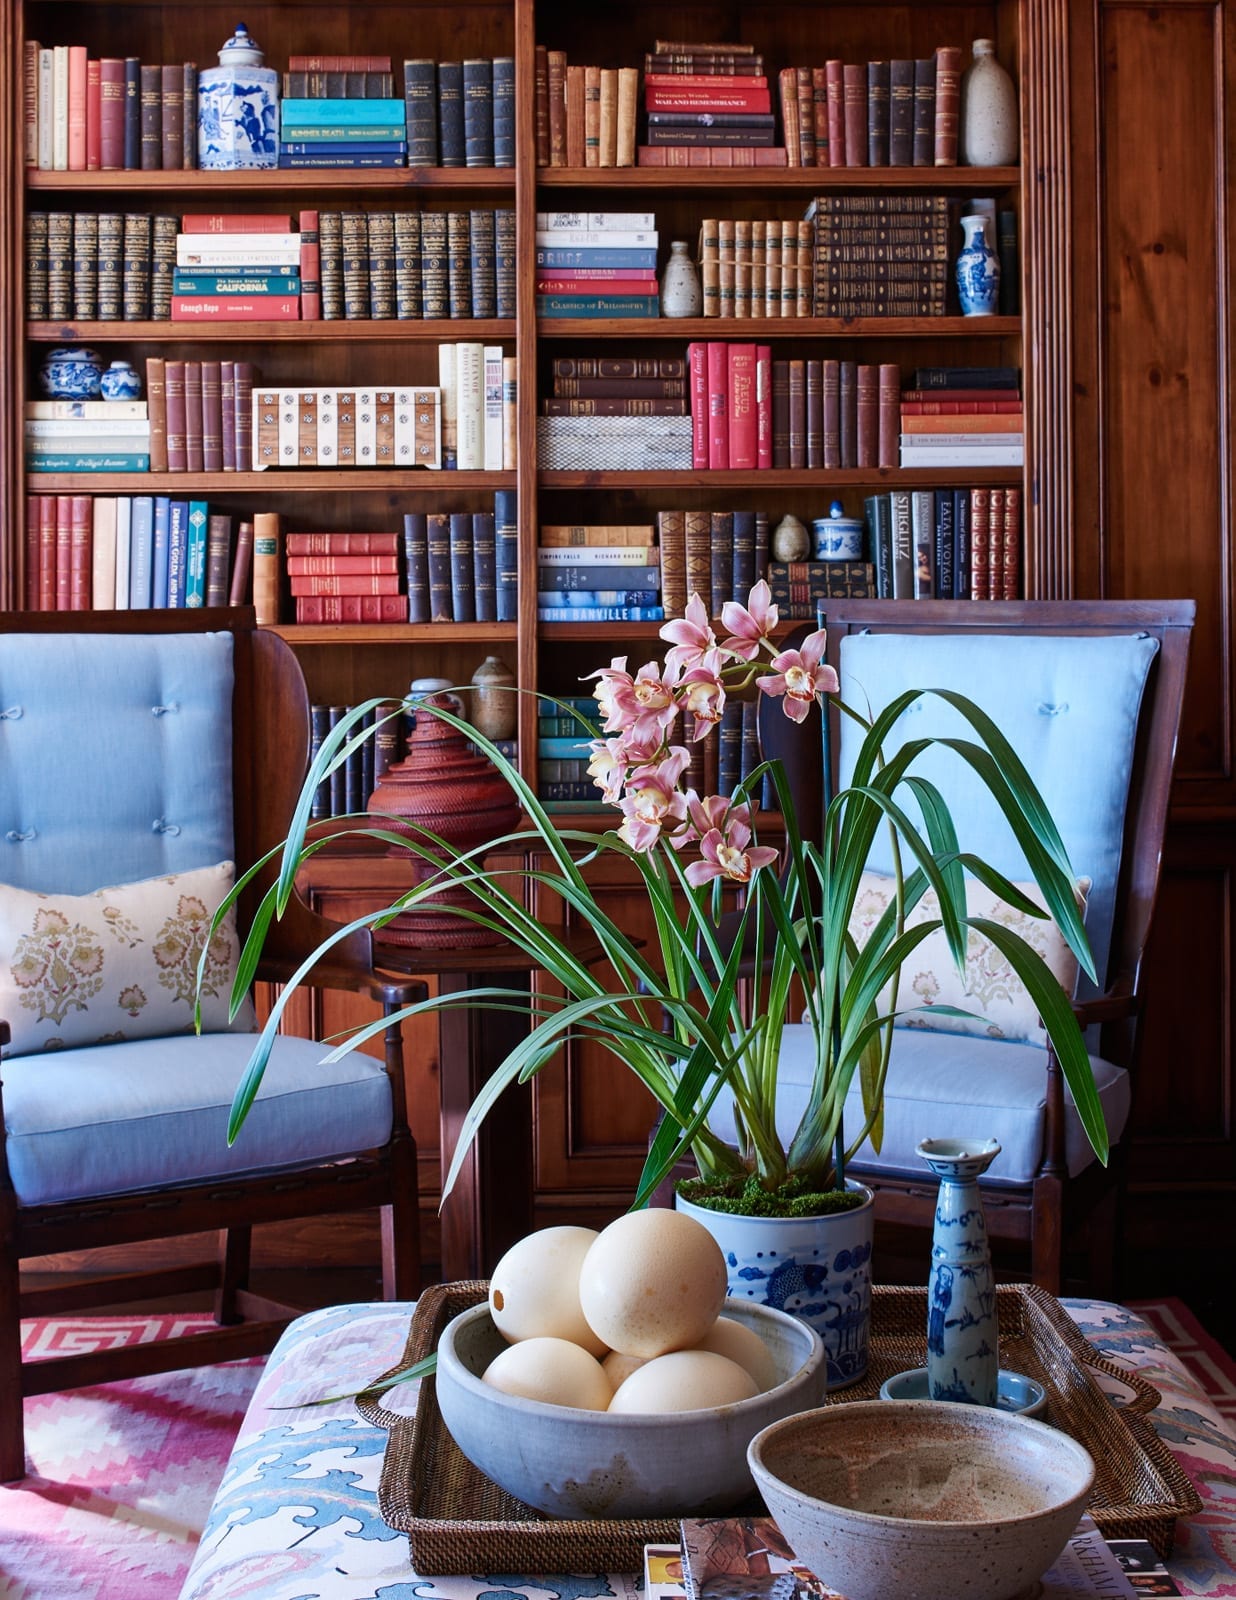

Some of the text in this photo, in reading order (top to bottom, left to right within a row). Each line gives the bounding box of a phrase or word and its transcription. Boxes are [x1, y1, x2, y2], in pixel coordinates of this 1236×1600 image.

[216, 283, 268, 292] CALIFORNIA
[471, 353, 480, 394] ELEANOR
[740, 376, 751, 414] FREUD
[898, 496, 910, 560] STIEGLITZ
[920, 494, 930, 543] LEONARDO
[943, 501, 952, 591] FATAL VOYAGE
[170, 578, 179, 594] AND
[573, 608, 628, 620] BANVILLE
